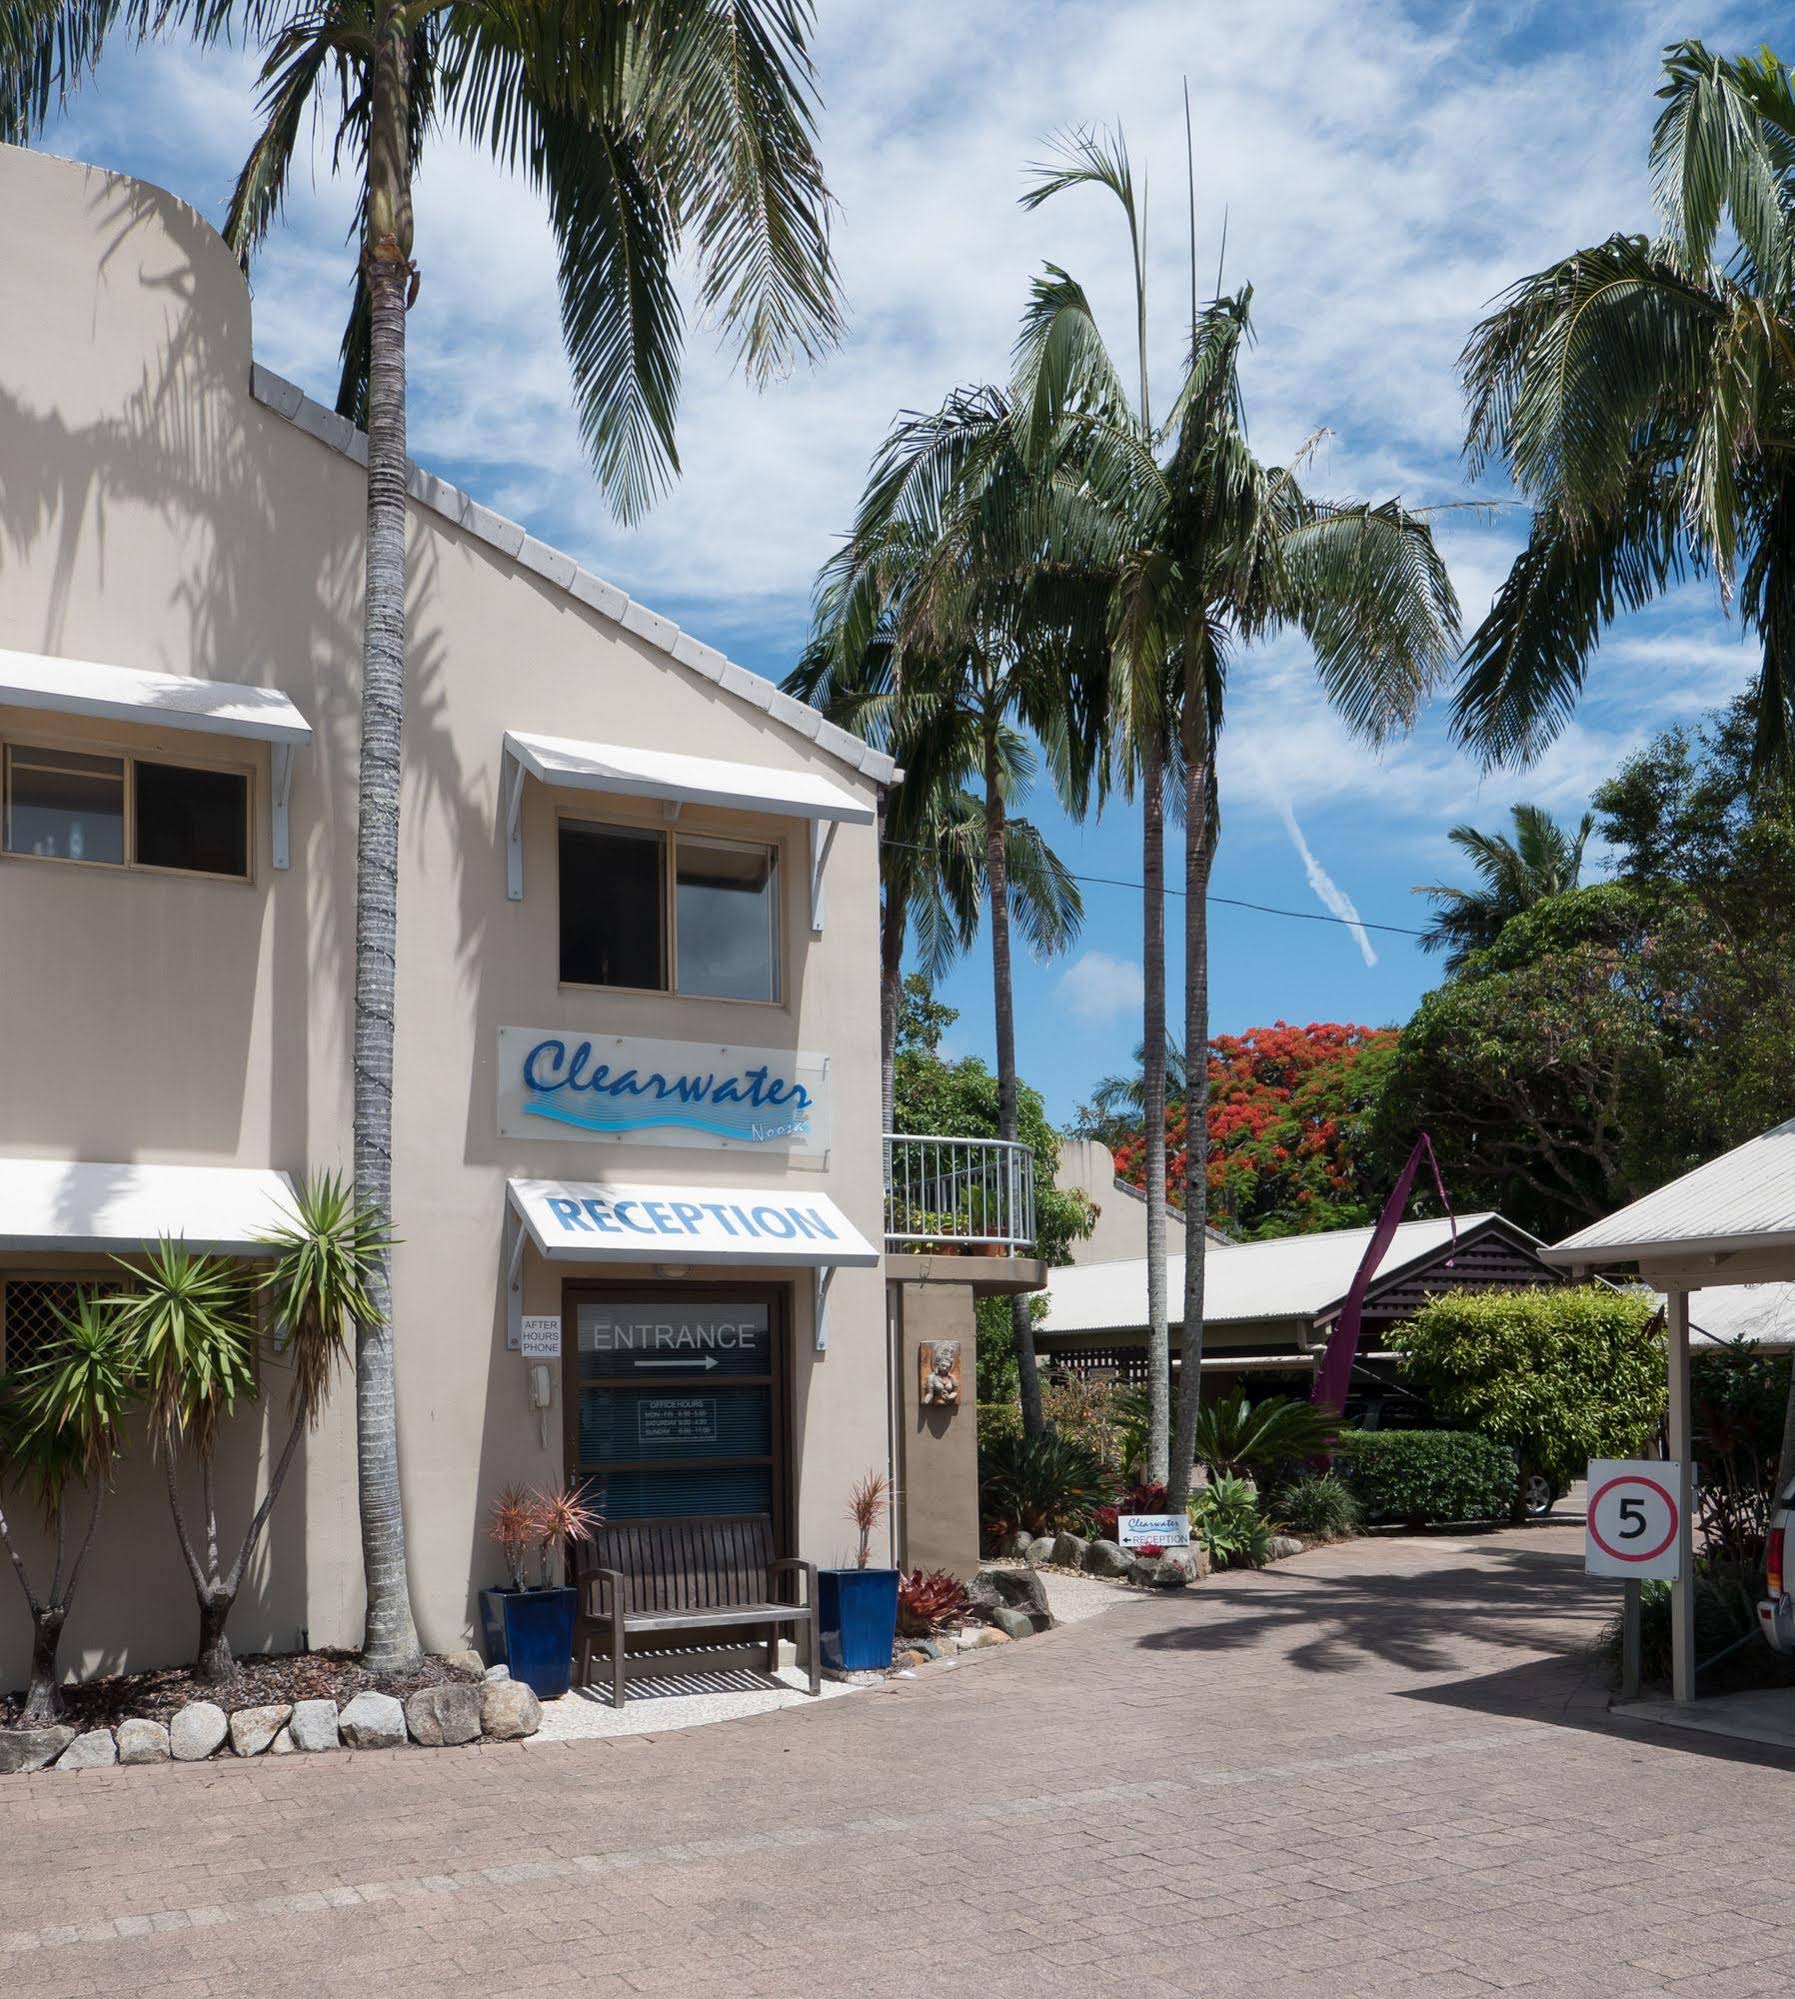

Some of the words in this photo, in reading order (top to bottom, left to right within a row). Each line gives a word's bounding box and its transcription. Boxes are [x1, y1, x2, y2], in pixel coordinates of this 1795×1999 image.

[523, 1039, 813, 1109] Clearwater
[751, 1122, 804, 1143] Noosa
[545, 1197, 840, 1240] RECEPTION
[525, 1321, 558, 1329] AFTER
[523, 1332, 559, 1341] HOURS
[594, 1324, 756, 1350] ENTRANCE
[523, 1343, 559, 1352] PHONE
[650, 1401, 677, 1409] OFFICE
[677, 1400, 704, 1408] HOURS
[1128, 1517, 1180, 1528] Clearwater
[1618, 1498, 1647, 1539] 5
[1133, 1534, 1188, 1544] RECEPTION
